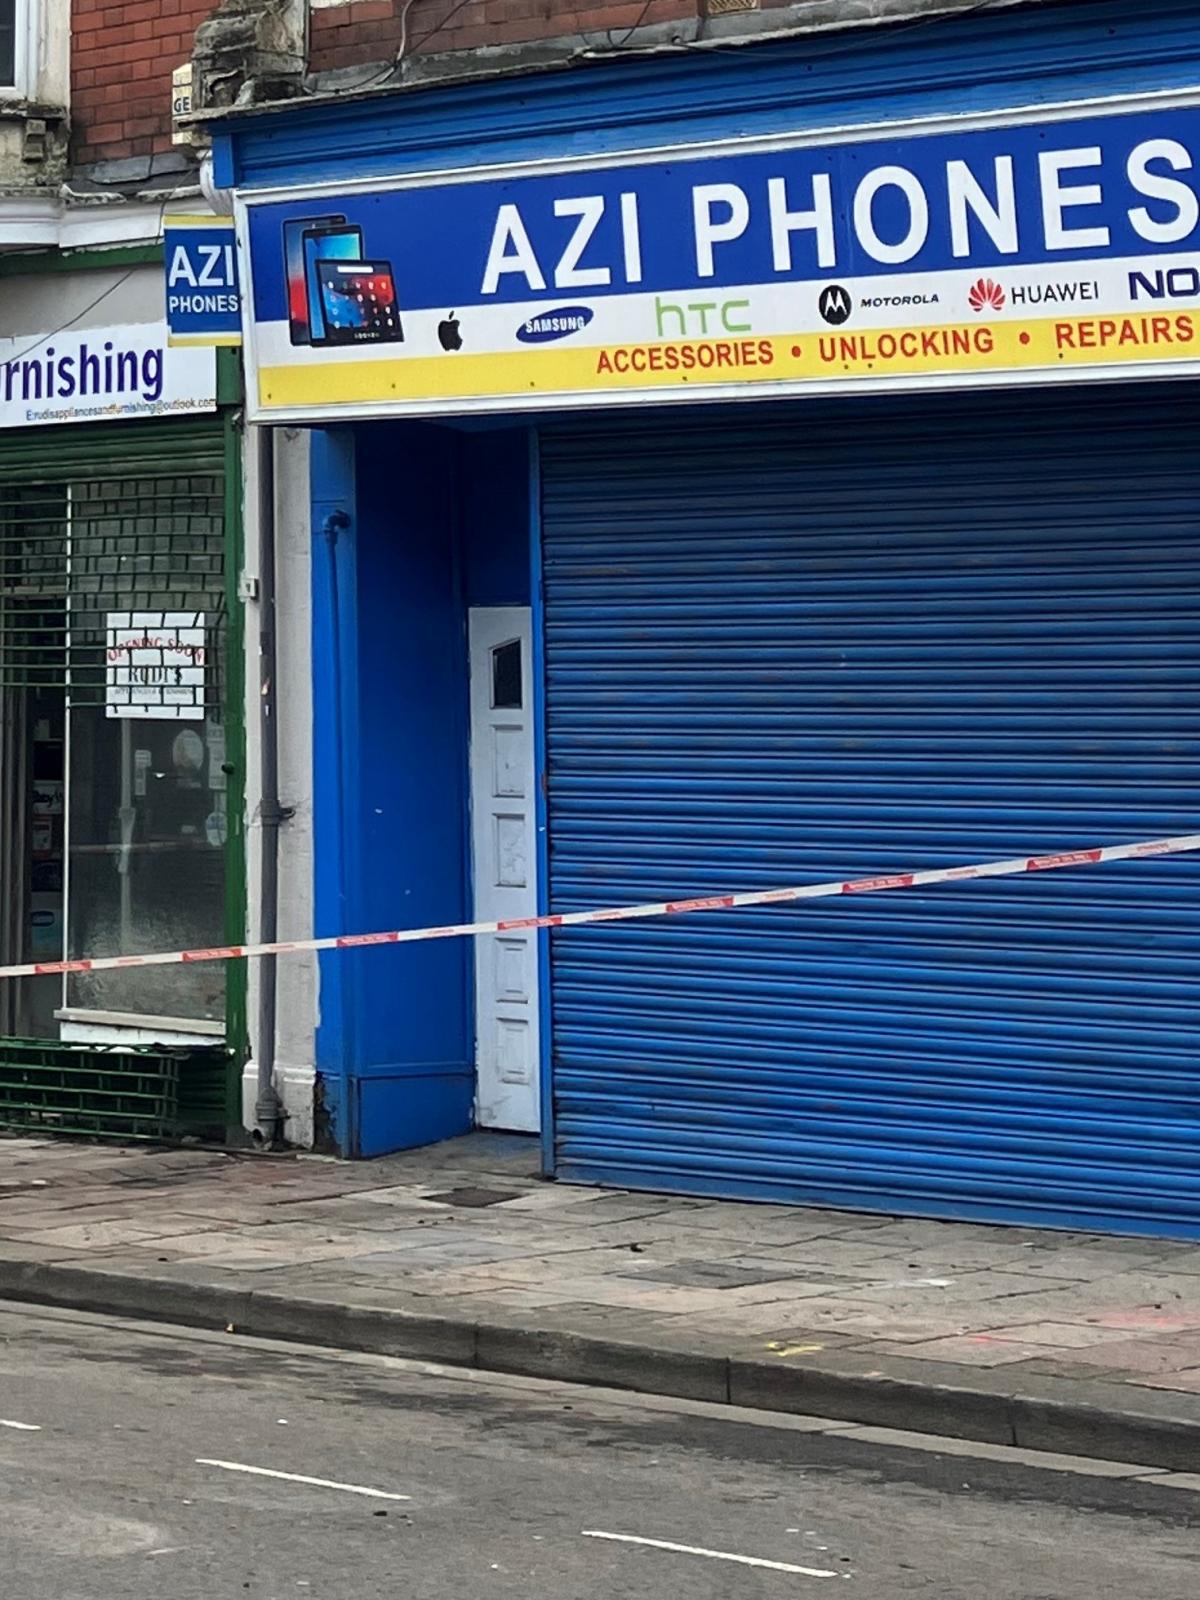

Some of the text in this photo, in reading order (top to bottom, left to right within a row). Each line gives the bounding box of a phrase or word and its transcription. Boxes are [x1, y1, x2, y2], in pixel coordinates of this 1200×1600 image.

[480, 139, 1199, 295] AZI PHONES
[168, 244, 235, 287] AZI
[169, 294, 239, 314] PHONES
[525, 314, 586, 334] SAMSUNG
[860, 293, 939, 308] MOTOROLA
[1011, 282, 1099, 306] HUAWEI
[596, 315, 1194, 374] ACCESSORIES UNLOCKING REPAIRS
